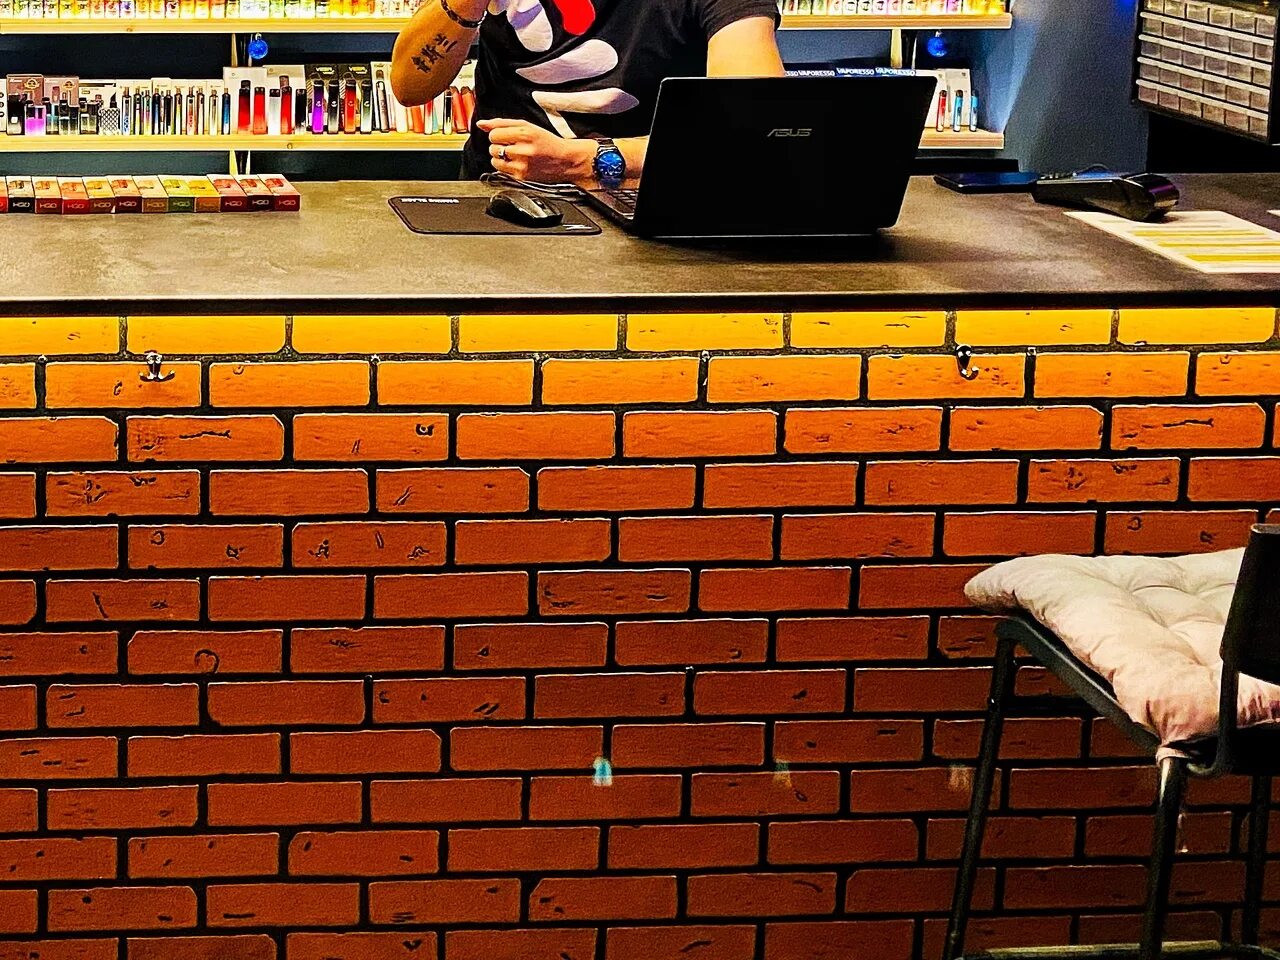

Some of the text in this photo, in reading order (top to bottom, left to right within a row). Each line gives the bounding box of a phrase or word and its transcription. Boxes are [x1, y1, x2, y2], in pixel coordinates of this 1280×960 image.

[836, 67, 875, 75] VAPORESSO
[875, 67, 916, 77] VAPORESSO
[767, 128, 813, 137] ASUS
